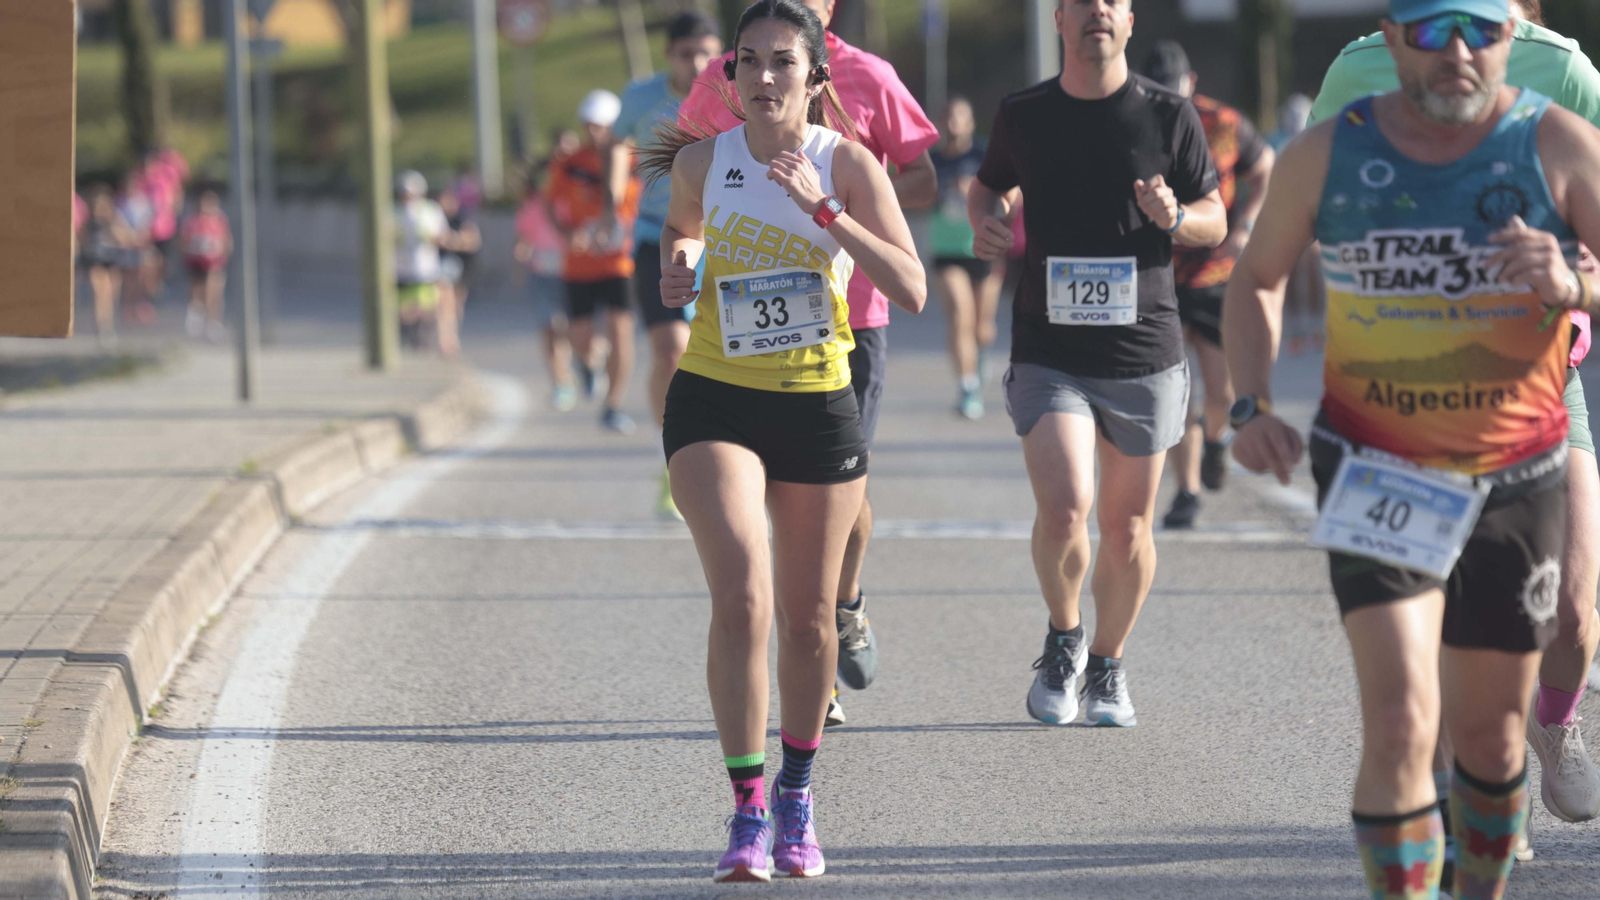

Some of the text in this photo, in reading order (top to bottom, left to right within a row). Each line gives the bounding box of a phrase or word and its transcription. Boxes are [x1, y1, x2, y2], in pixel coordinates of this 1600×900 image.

[705, 234, 801, 271] CARPE
[1373, 235, 1461, 262] TRAIL
[1073, 265, 1110, 276] MARATÓN
[1359, 268, 1439, 290] TEAM
[750, 278, 794, 292] MARATÓN
[1067, 280, 1110, 305] 129
[753, 296, 789, 330] 33
[1069, 312, 1111, 321] EVOS
[752, 333, 803, 349] EVOS
[1365, 380, 1519, 417] Algeciras
[1366, 496, 1412, 532] 40
